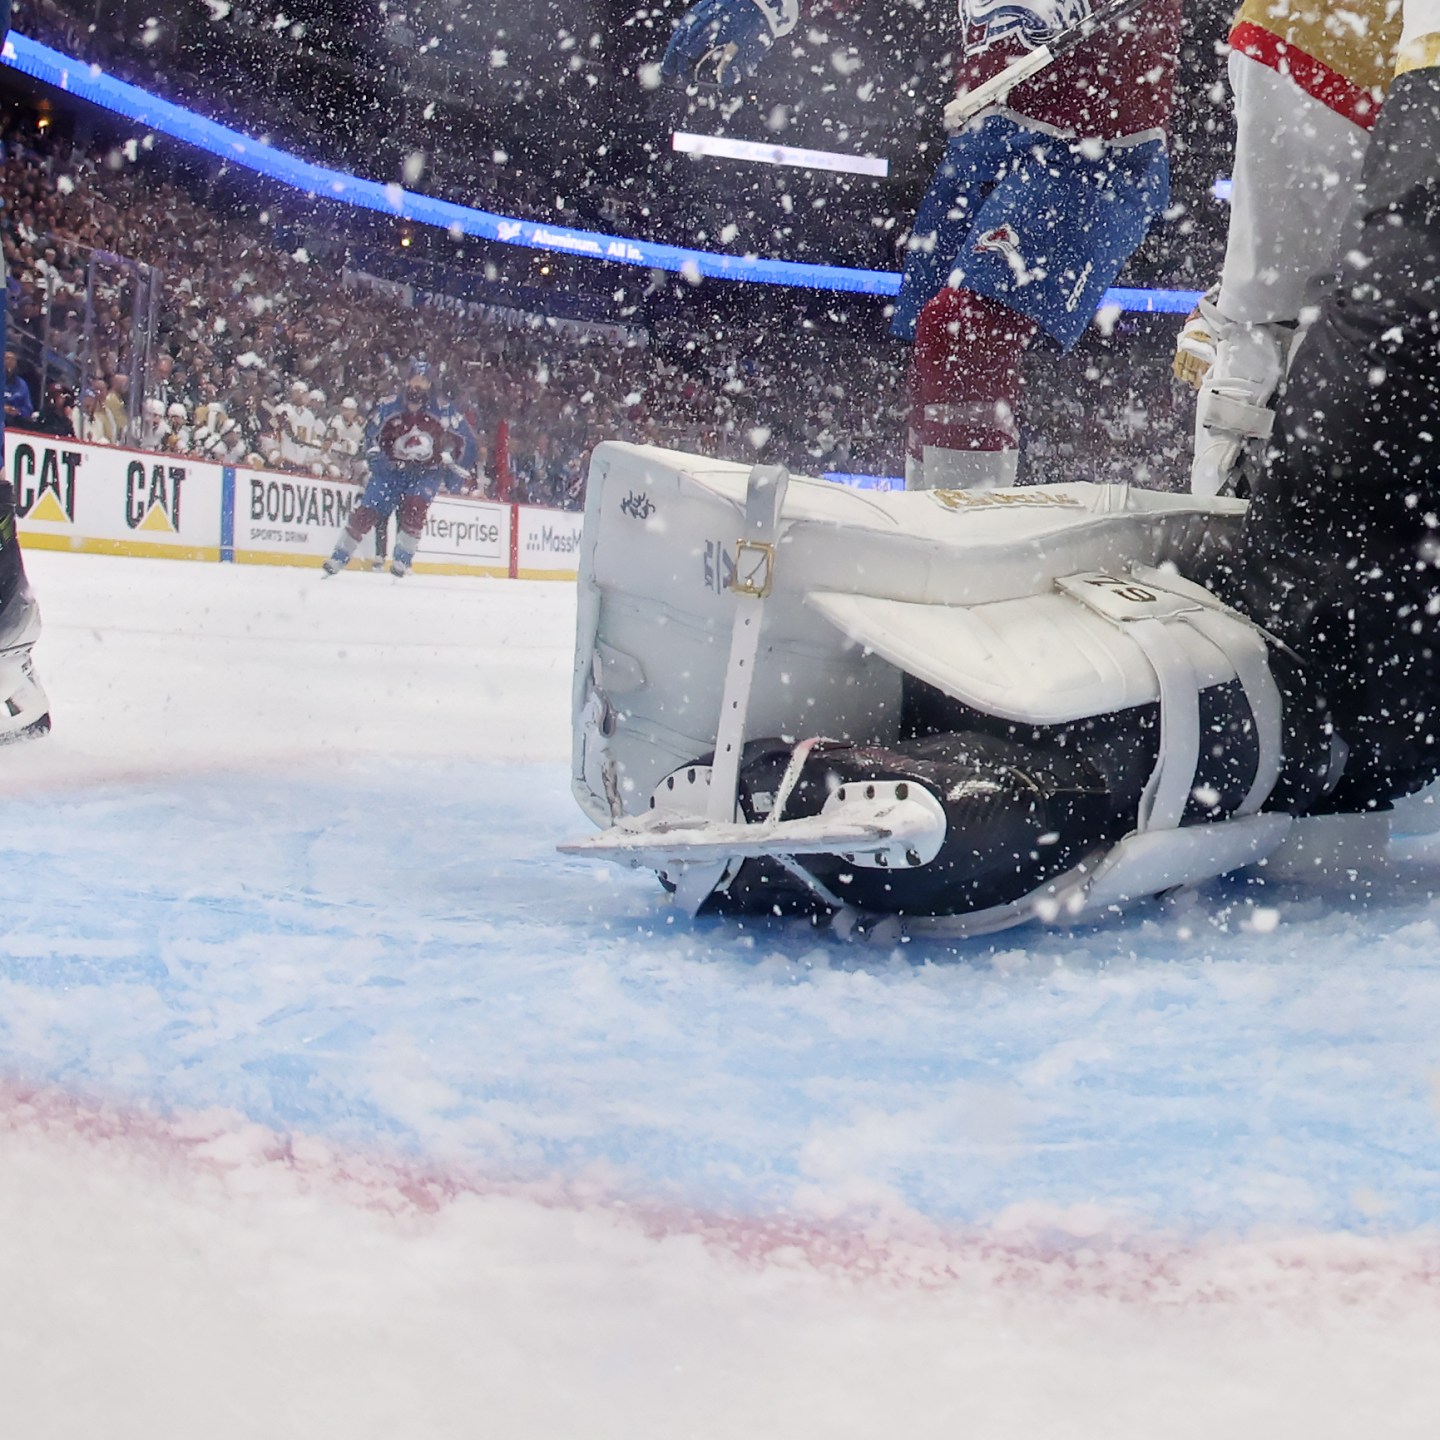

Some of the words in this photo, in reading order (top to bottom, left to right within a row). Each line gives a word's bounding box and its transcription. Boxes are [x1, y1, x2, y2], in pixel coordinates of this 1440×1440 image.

[532, 229, 603, 254] Aluminum.
[607, 241, 625, 258] All
[13, 443, 82, 524] CAT
[126, 460, 187, 534] CAT
[250, 528, 283, 543] SPORTS
[284, 532, 309, 544] DRINK
